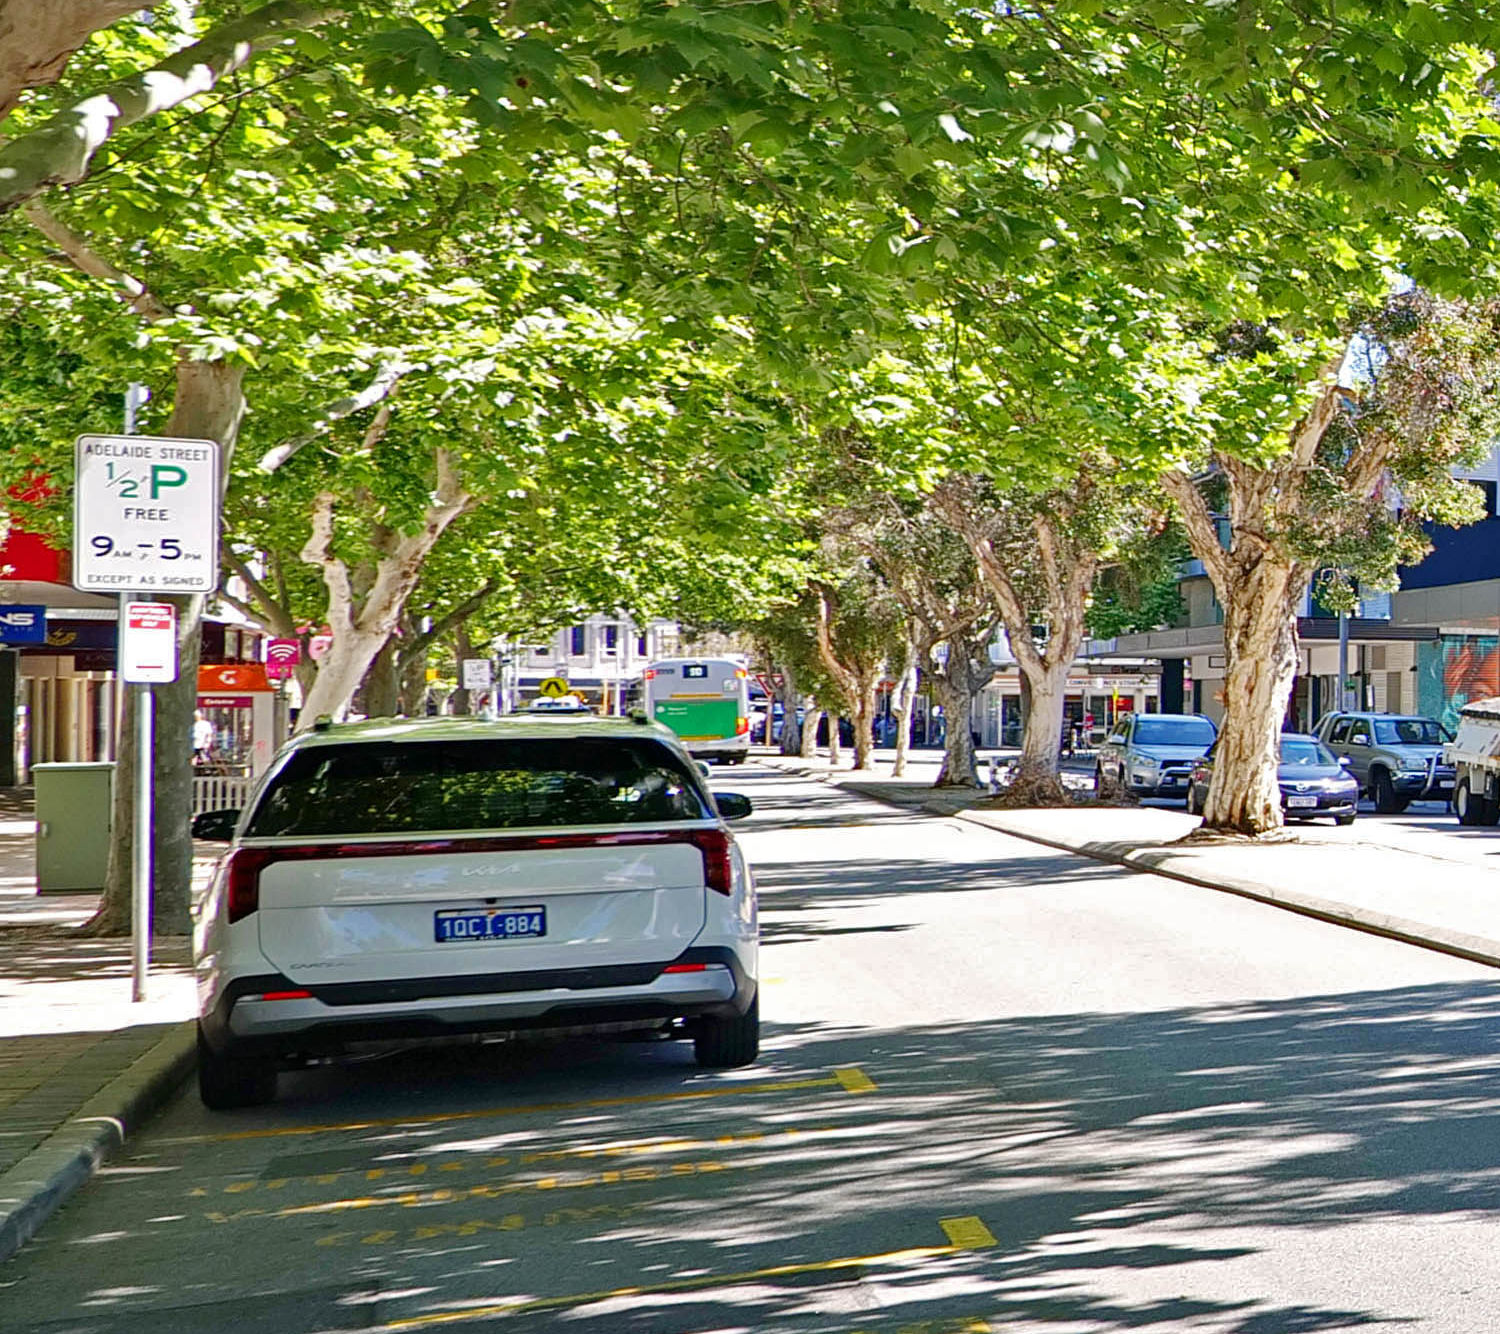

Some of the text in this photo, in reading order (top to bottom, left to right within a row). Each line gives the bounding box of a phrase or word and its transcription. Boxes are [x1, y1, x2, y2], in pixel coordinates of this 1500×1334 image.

[85, 444, 209, 461] ADELAIDE STREET
[124, 508, 169, 521] FREE
[87, 575, 204, 586] EXCEPT AS SIGNED
